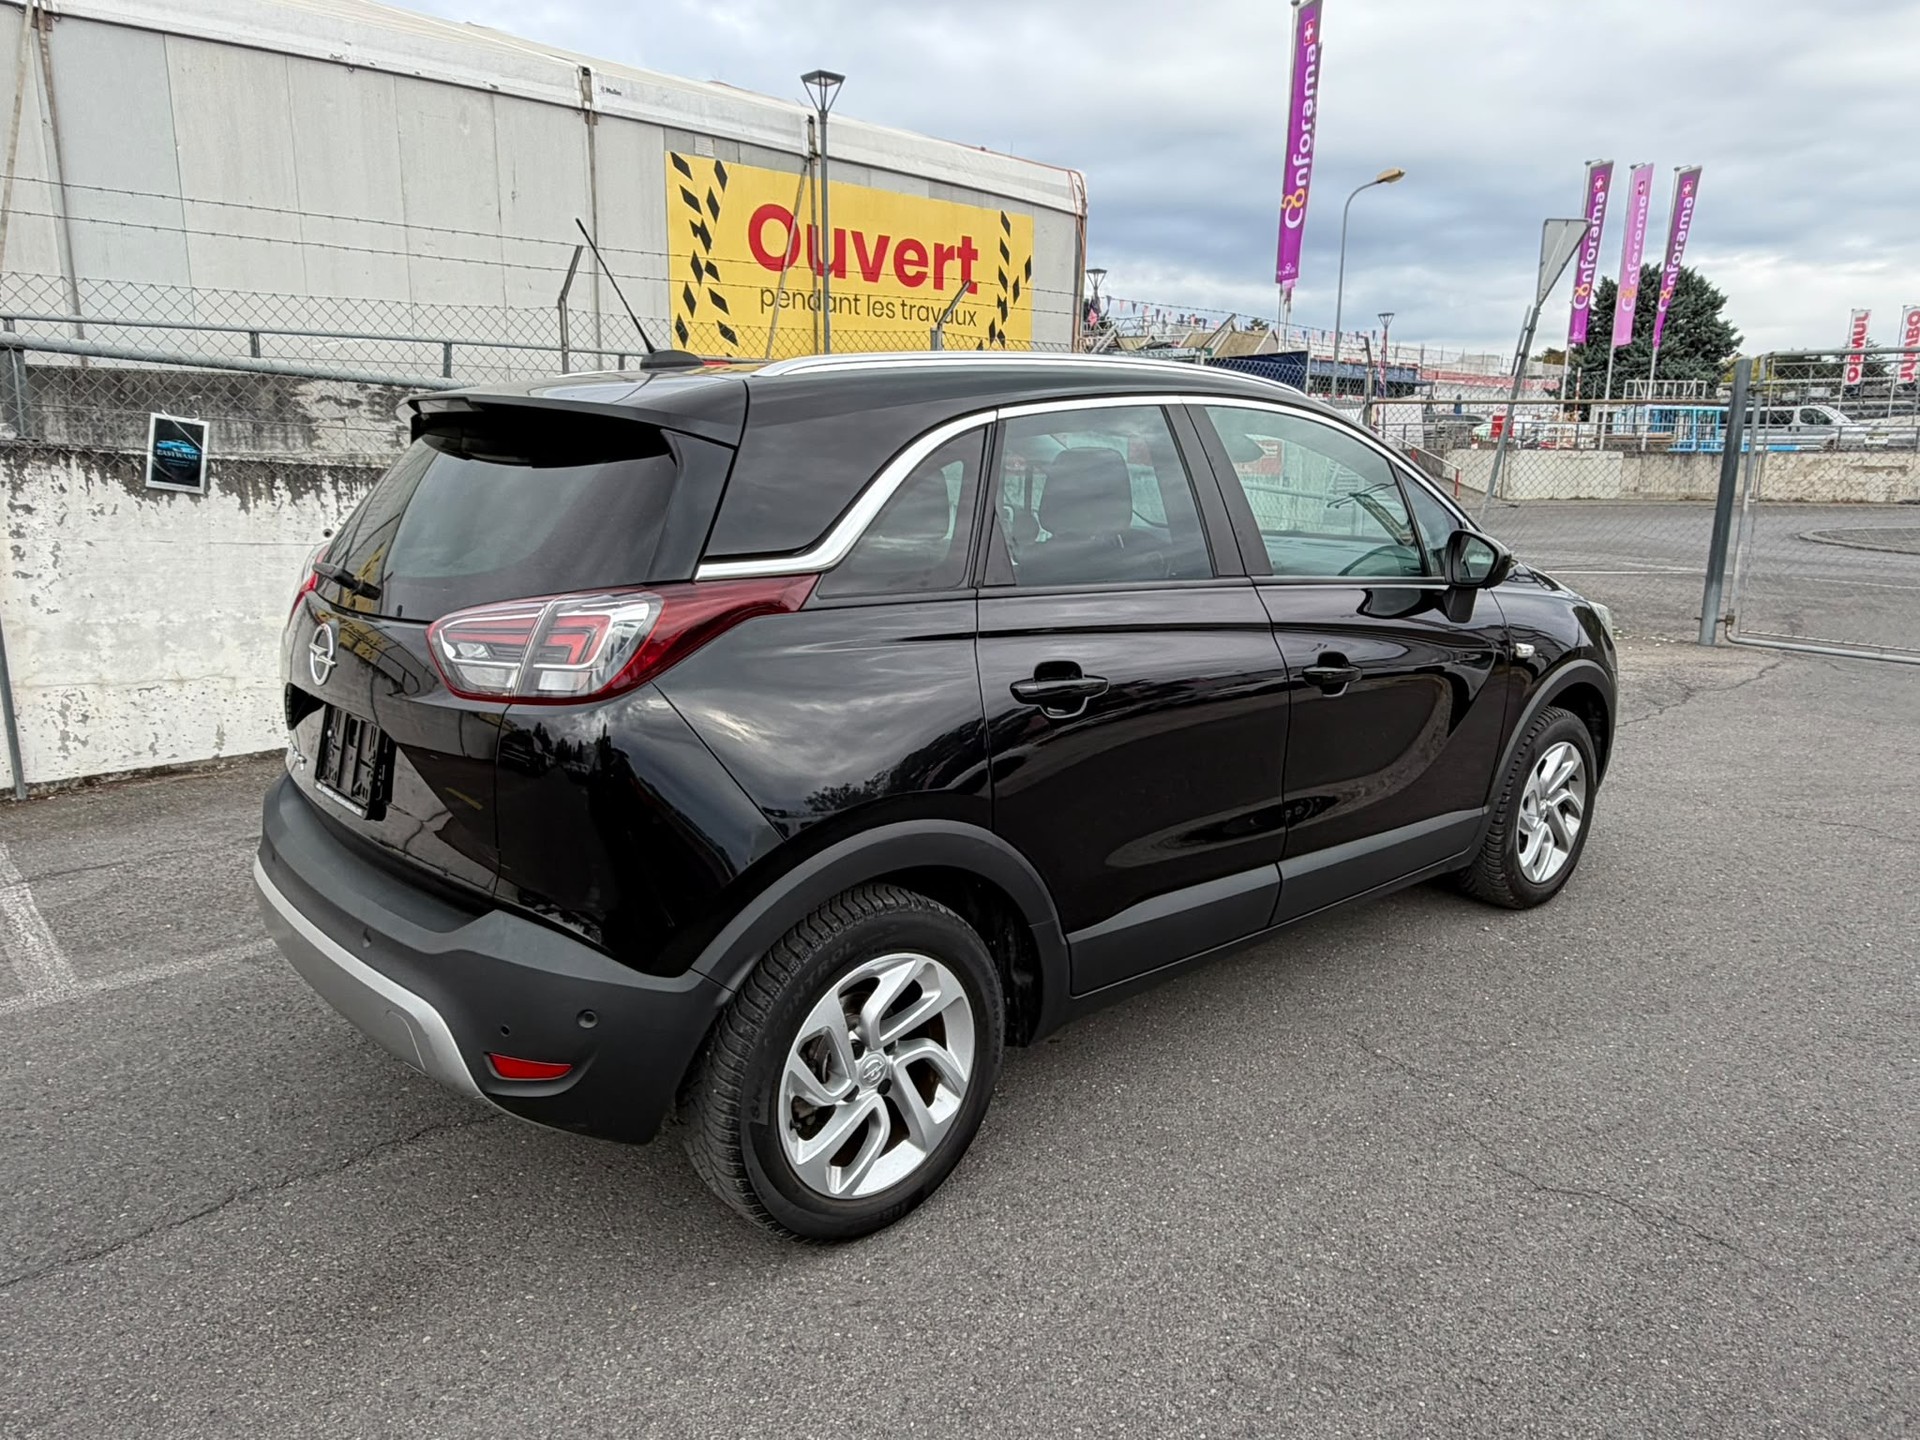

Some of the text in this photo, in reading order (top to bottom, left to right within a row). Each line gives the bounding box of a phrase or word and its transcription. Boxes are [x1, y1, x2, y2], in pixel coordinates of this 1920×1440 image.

[1282, 44, 1317, 229] Conforama
[748, 203, 978, 294] Ouvert
[1573, 190, 1606, 310] Conforama
[1658, 196, 1694, 312] Conforama
[760, 286, 977, 328] pendant les travaux
